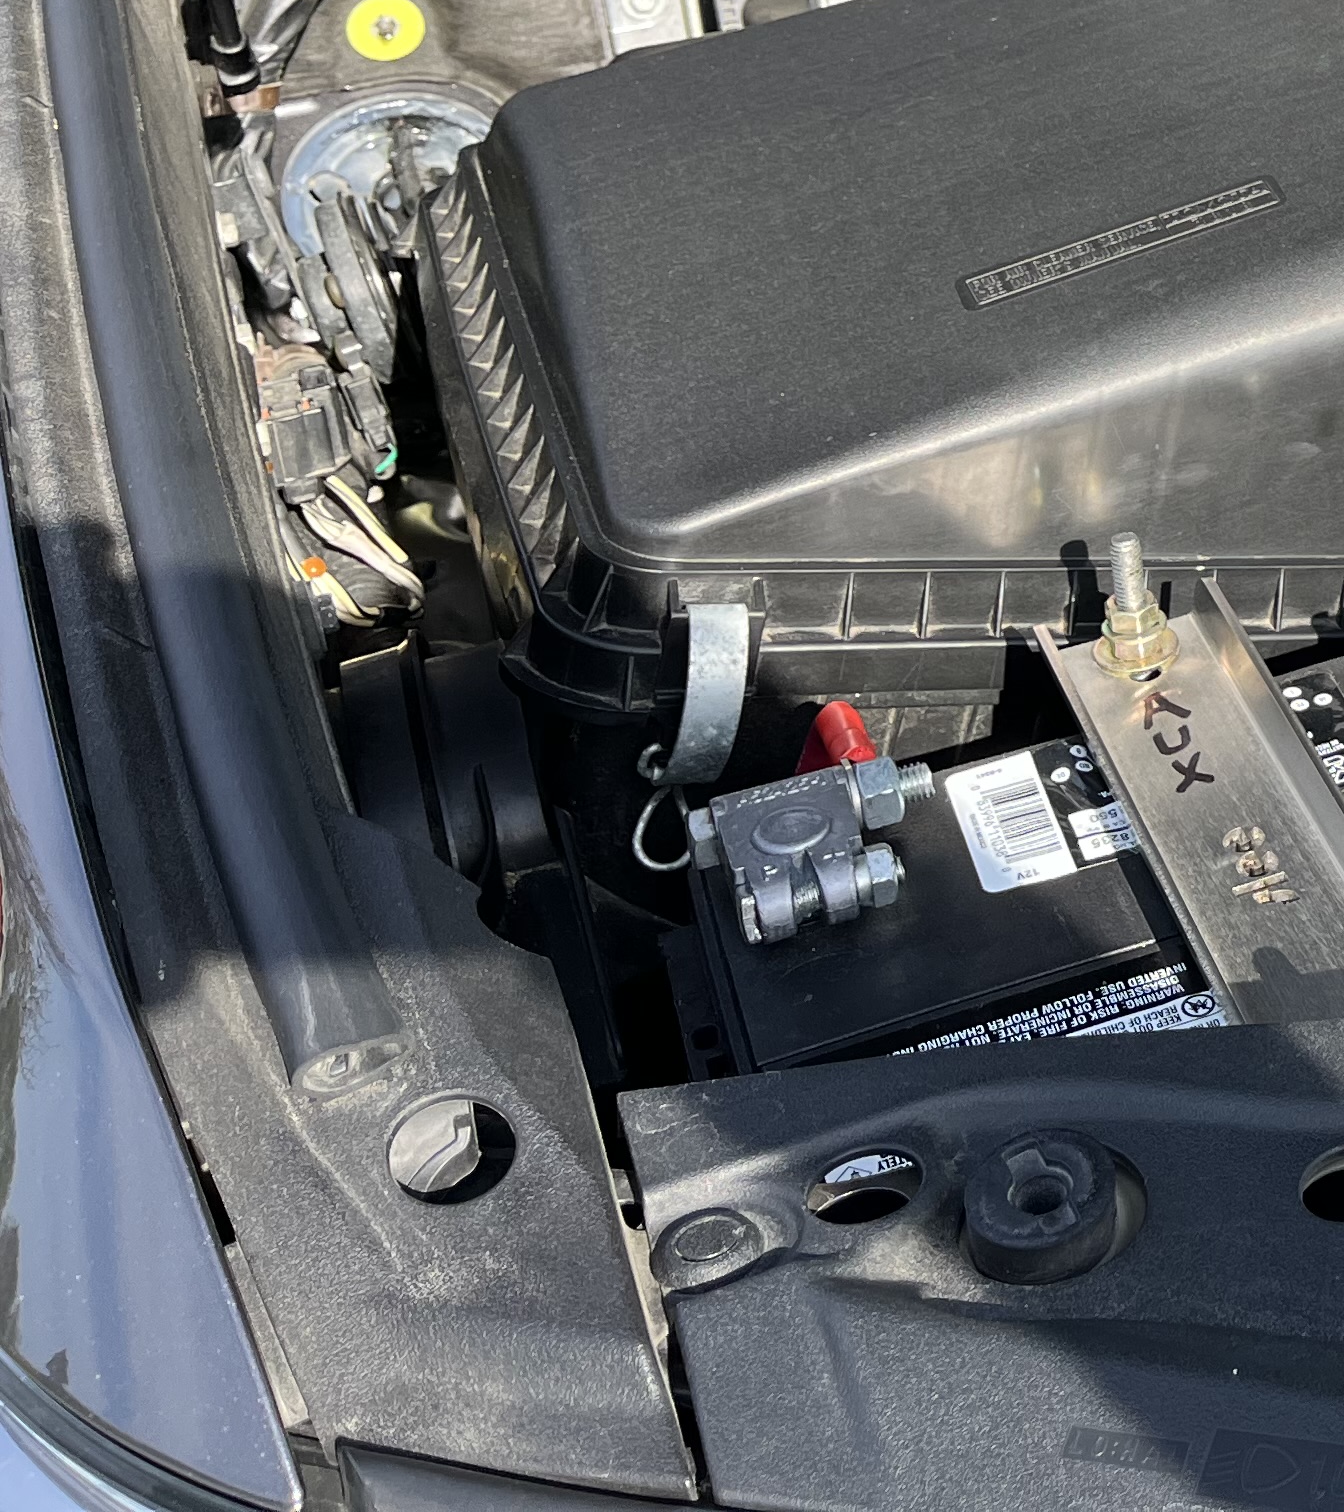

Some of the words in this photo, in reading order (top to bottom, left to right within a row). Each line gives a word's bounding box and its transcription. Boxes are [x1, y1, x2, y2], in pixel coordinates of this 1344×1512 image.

[1088, 807, 1118, 823] 550
[1014, 866, 1040, 881] 12V
[1126, 960, 1186, 988] INVERTED
[1092, 973, 1179, 1008] DISASSEMBLE
[1119, 982, 1184, 1010] WARNING:
[1040, 989, 1093, 1014] FOLLOW
[1071, 1000, 1092, 1015] OR
[986, 1006, 1039, 1031] PROPER
[1068, 1013, 1087, 1027] OF
[1087, 1002, 1119, 1020] RISK
[1142, 1003, 1178, 1022] REACH
[1153, 1011, 1182, 1028] KEEP
[1125, 1014, 1141, 1027] OF
[916, 1023, 985, 1052] CHARGING
